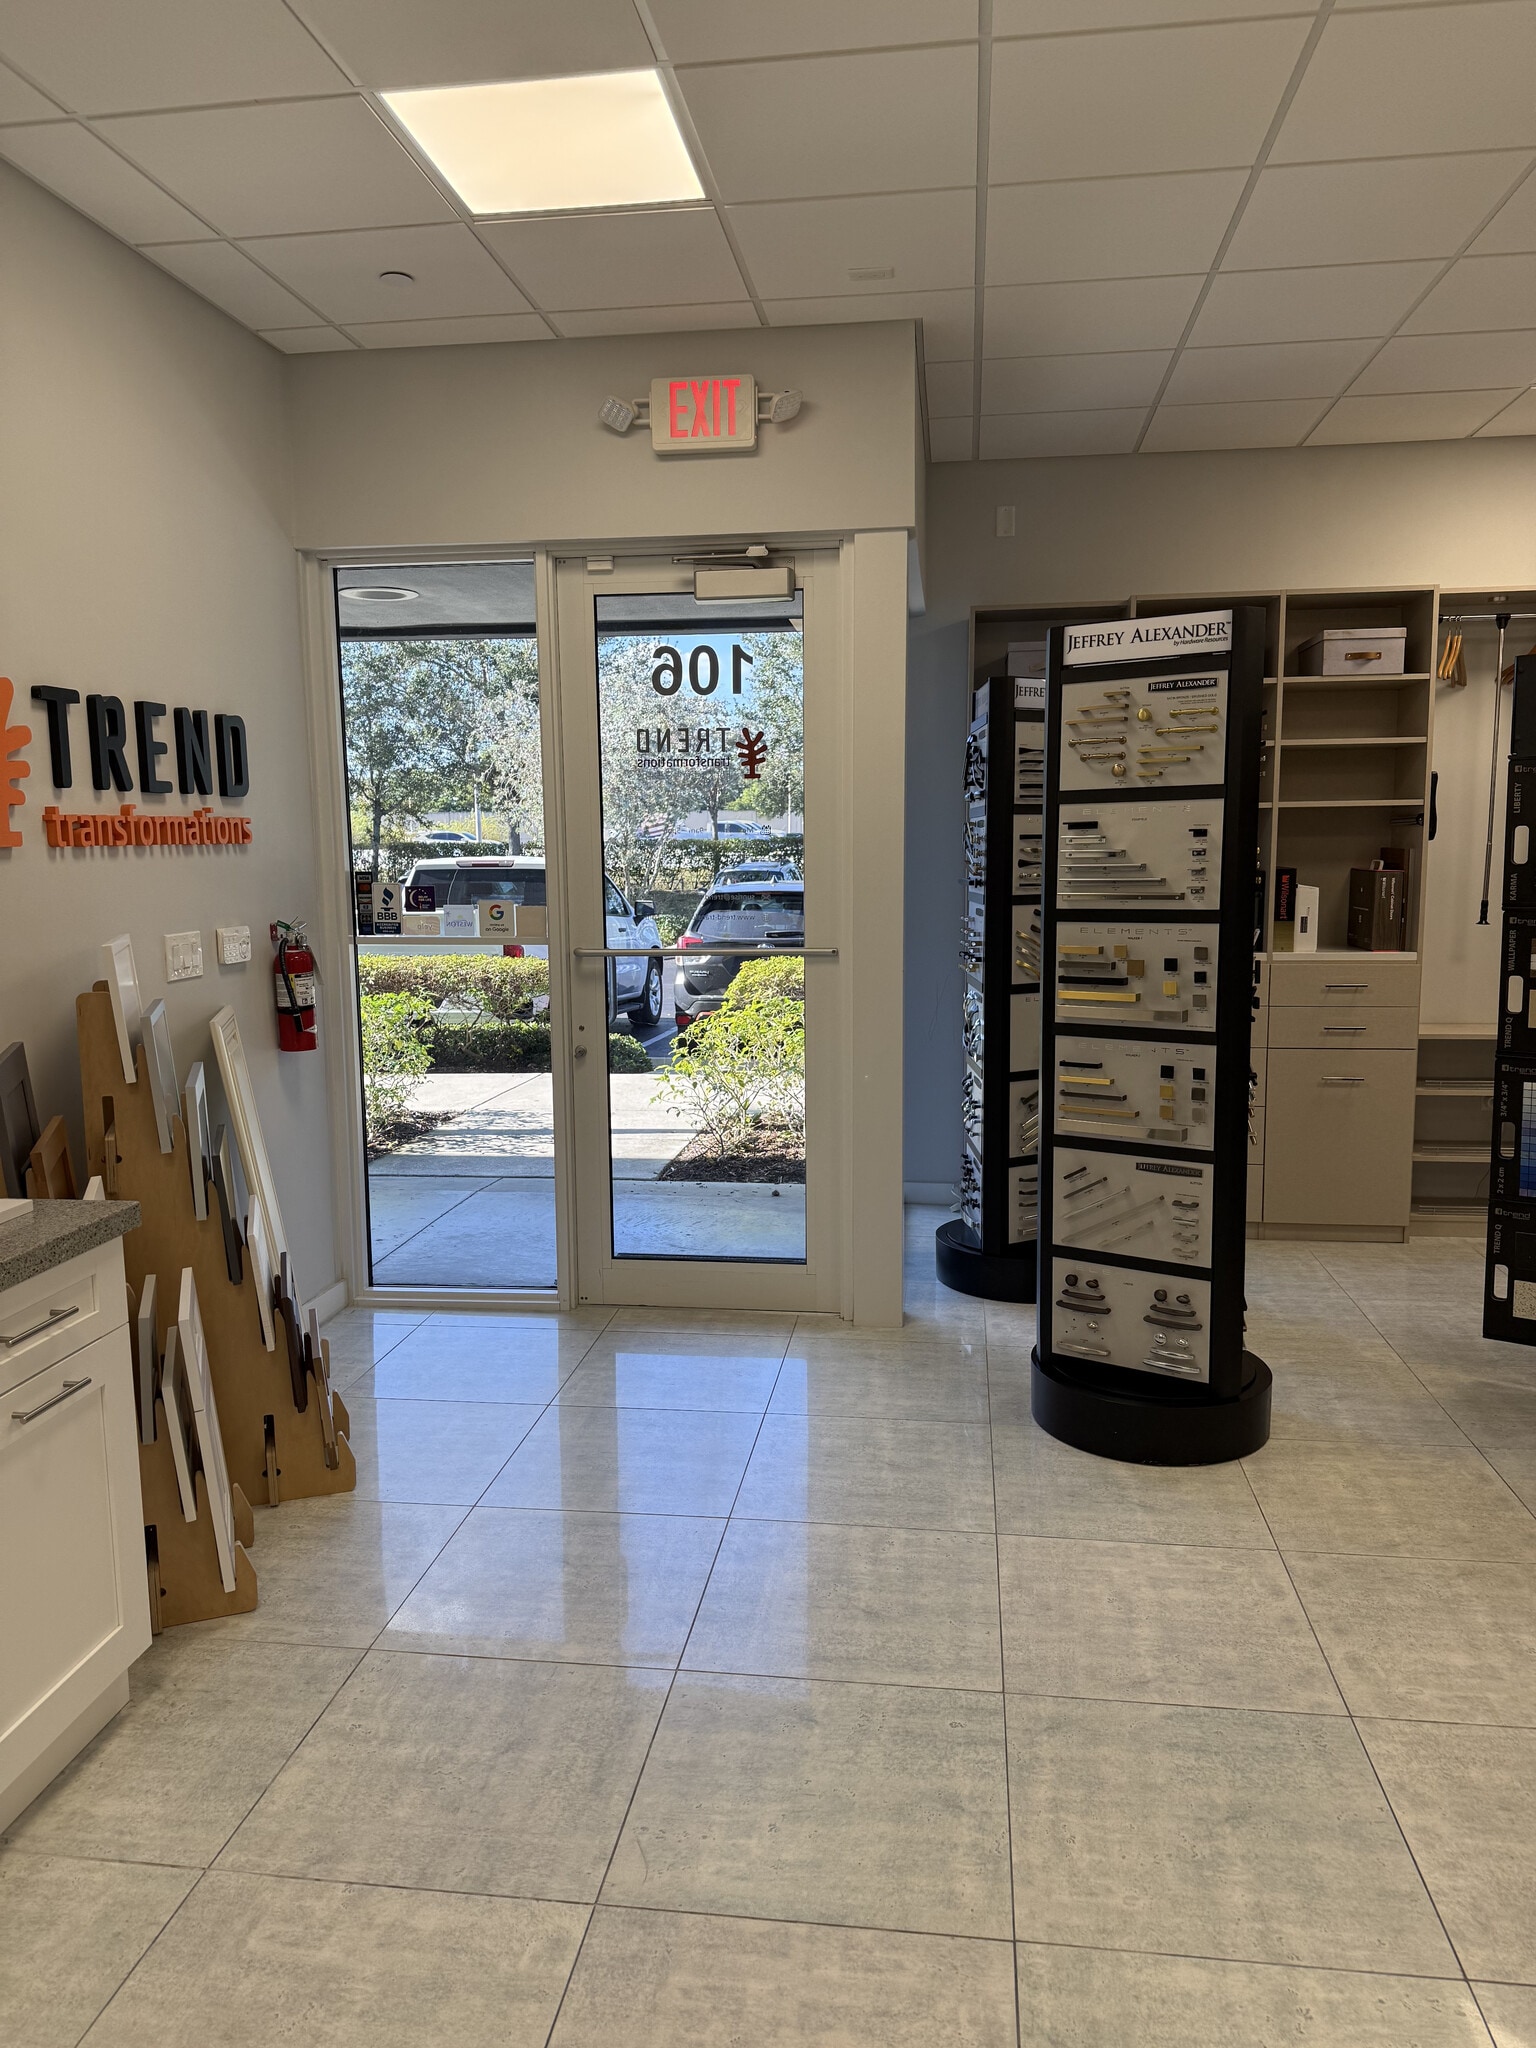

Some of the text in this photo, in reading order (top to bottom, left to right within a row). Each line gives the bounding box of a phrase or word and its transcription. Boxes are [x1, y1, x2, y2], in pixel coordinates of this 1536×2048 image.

[669, 379, 741, 438] EXIT
[1066, 631, 1125, 654] JEFFREY
[1180, 638, 1204, 646] Hardware
[1204, 636, 1229, 644] Resources
[1015, 685, 1045, 700] JEFFRE
[1150, 678, 1216, 691] JEFFREY ALEXANDER
[30, 685, 250, 797] TREND
[1513, 782, 1522, 814] LIBERTY
[42, 804, 253, 848] transformations
[1510, 873, 1518, 901] KARMA
[1280, 883, 1290, 919] Wilsonart
[377, 912, 398, 921] BBB
[1079, 927, 1192, 936] ELEMENTS
[1507, 929, 1517, 971] WALLPAPER
[1504, 1024, 1512, 1048] TREND
[1498, 1166, 1505, 1178] cm
[1493, 1231, 1502, 1254] TREND
